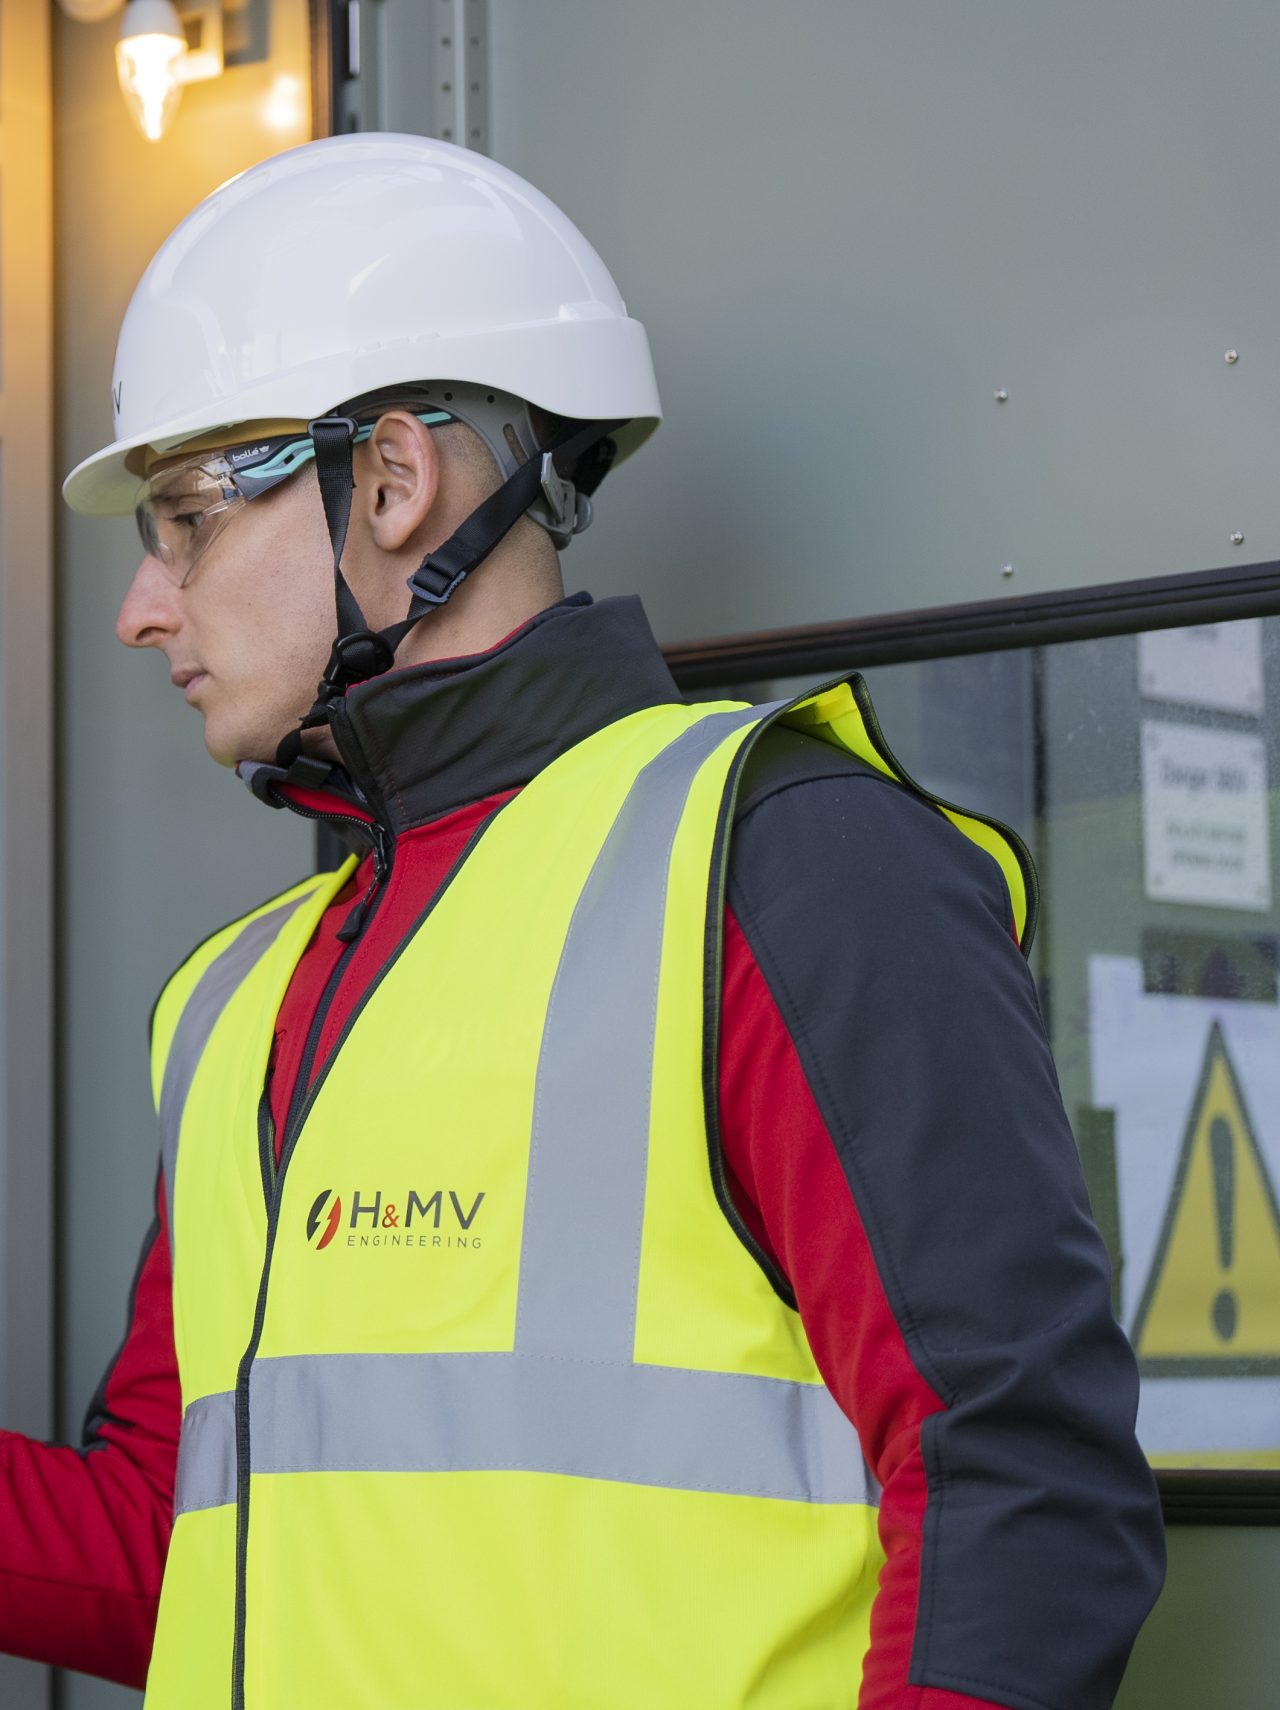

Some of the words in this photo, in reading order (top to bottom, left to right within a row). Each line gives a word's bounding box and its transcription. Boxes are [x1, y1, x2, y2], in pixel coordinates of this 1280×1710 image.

[232, 447, 259, 462] bollé
[350, 1190, 486, 1230] H&MV
[347, 1235, 482, 1249] ENGINEERING
